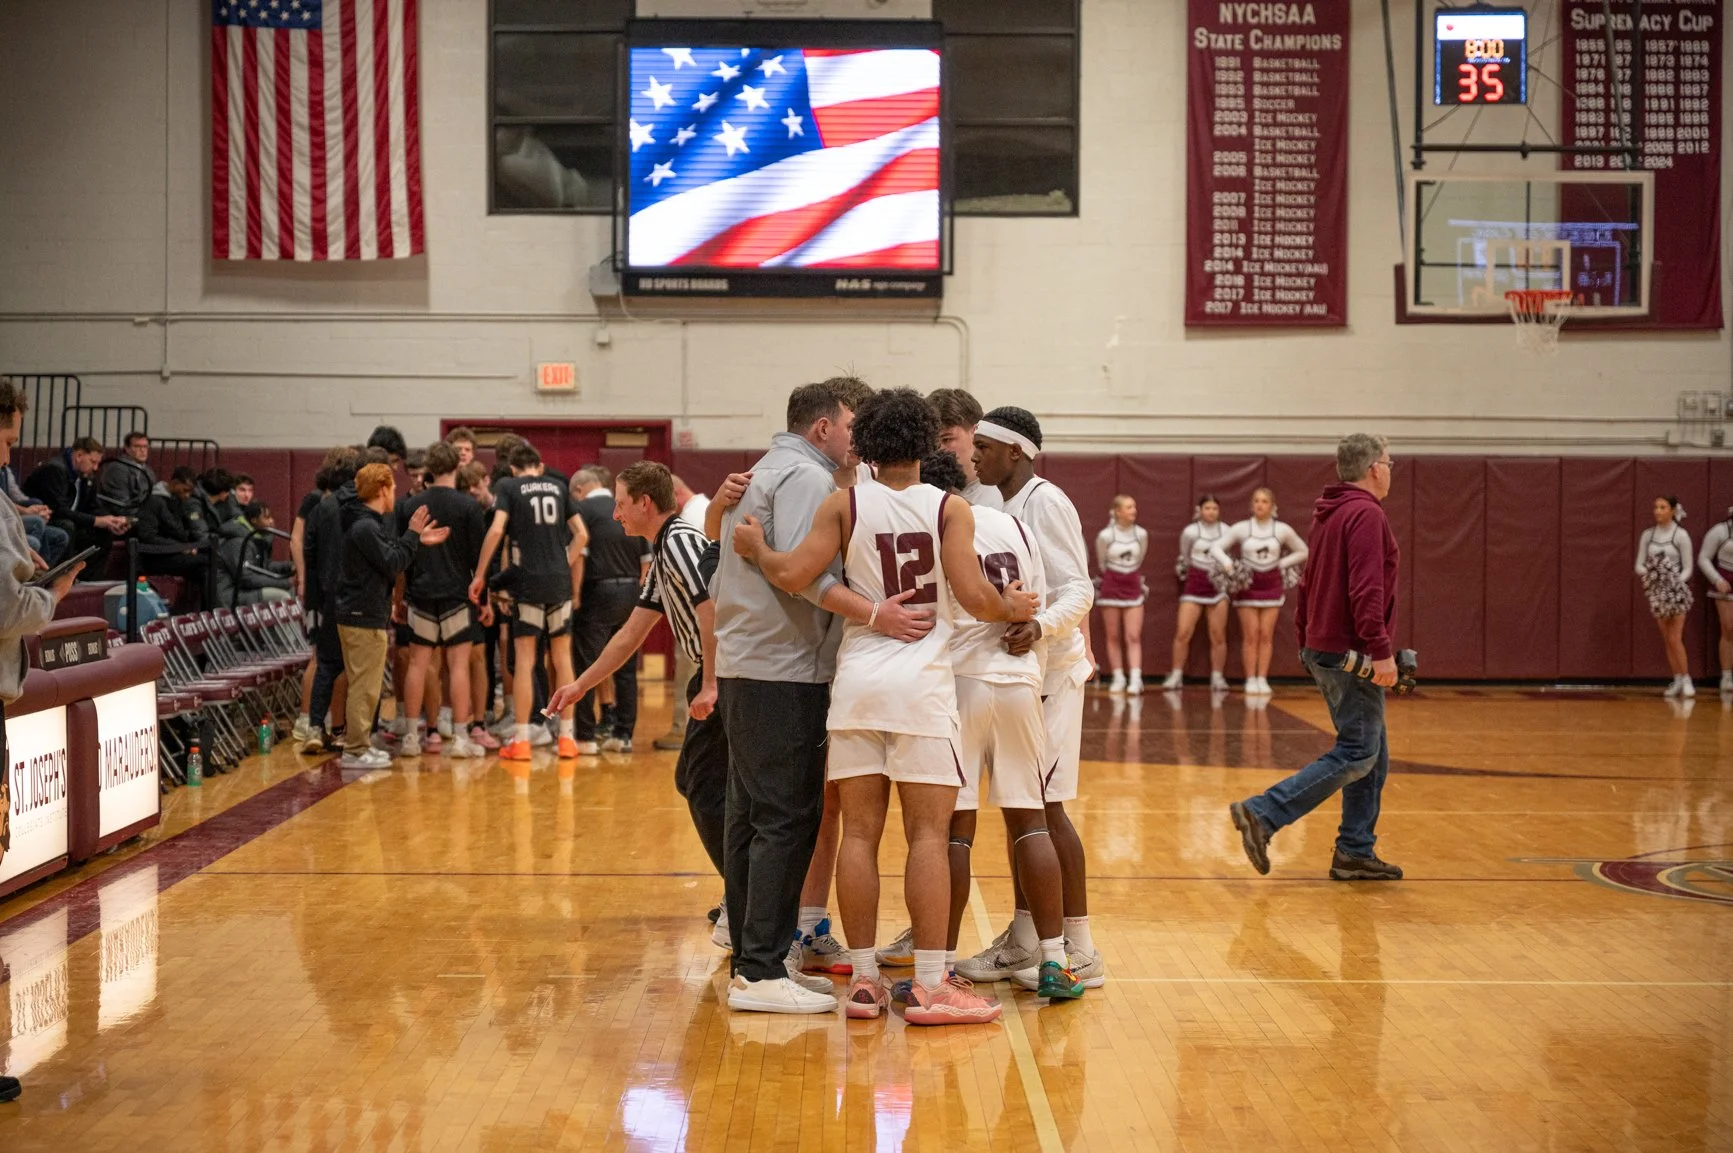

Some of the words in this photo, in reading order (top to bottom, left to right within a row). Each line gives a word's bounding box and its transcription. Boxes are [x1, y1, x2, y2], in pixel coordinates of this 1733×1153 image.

[1219, 3, 1317, 25] NYCHSAA
[1458, 63, 1504, 102] 35
[544, 365, 570, 385] EXIT
[530, 496, 557, 525] 10
[875, 532, 937, 605] 12
[64, 641, 78, 663] POSS
[14, 761, 27, 816] ST.
[30, 748, 66, 811] JOSEPH'S
